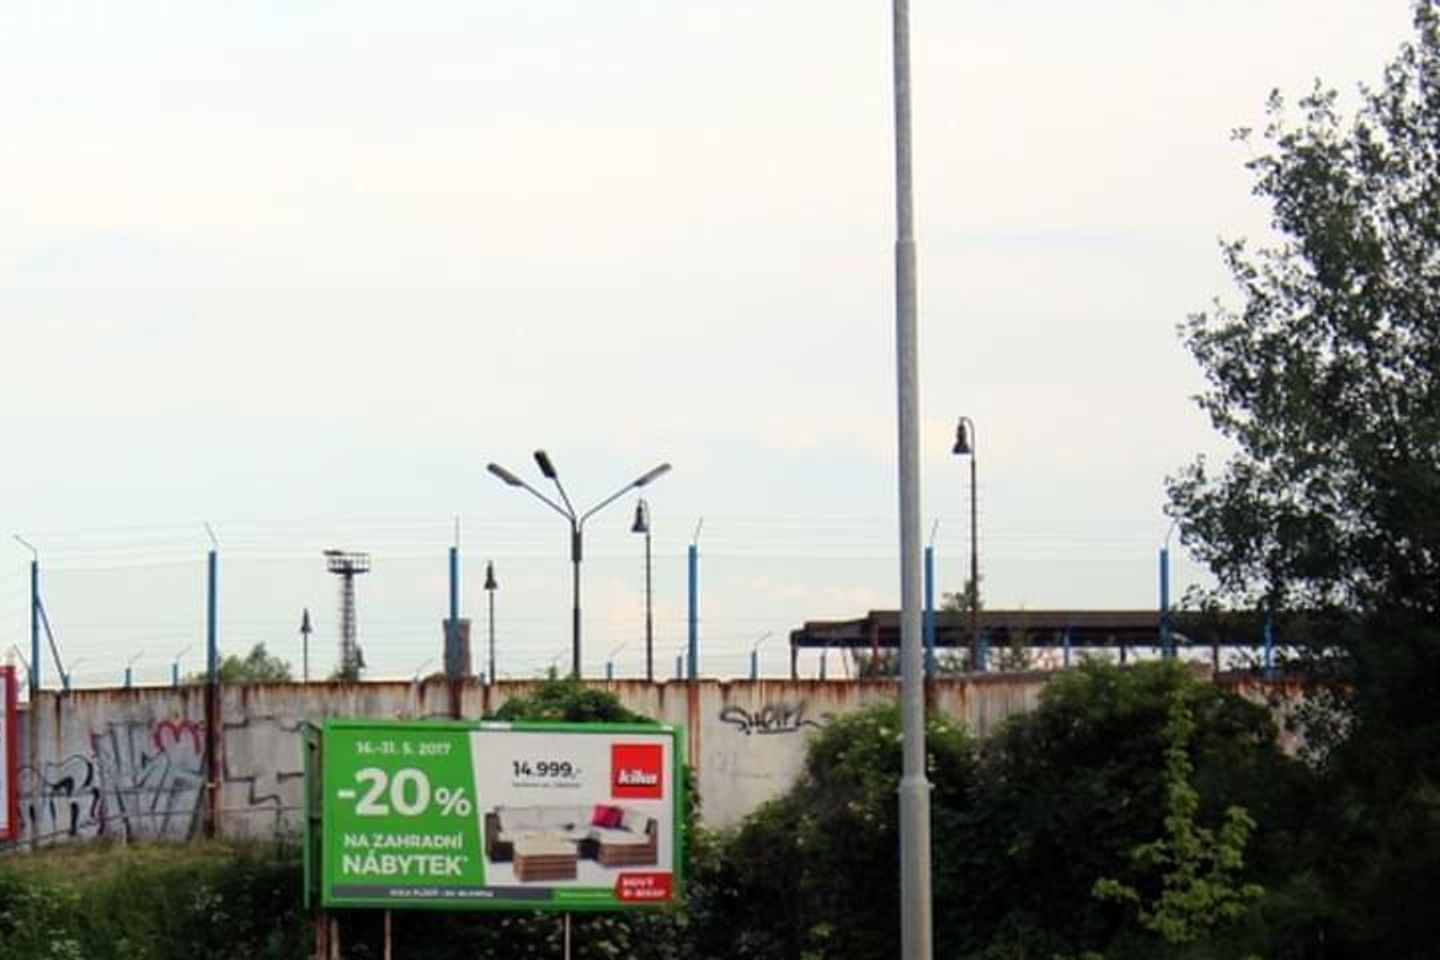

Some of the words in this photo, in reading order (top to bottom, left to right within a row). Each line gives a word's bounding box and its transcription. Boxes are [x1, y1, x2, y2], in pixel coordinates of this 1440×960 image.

[419, 742, 452, 756] 2017
[617, 768, 658, 786] kika
[343, 833, 369, 849] NA
[372, 832, 464, 850] ZAHRADNÍ
